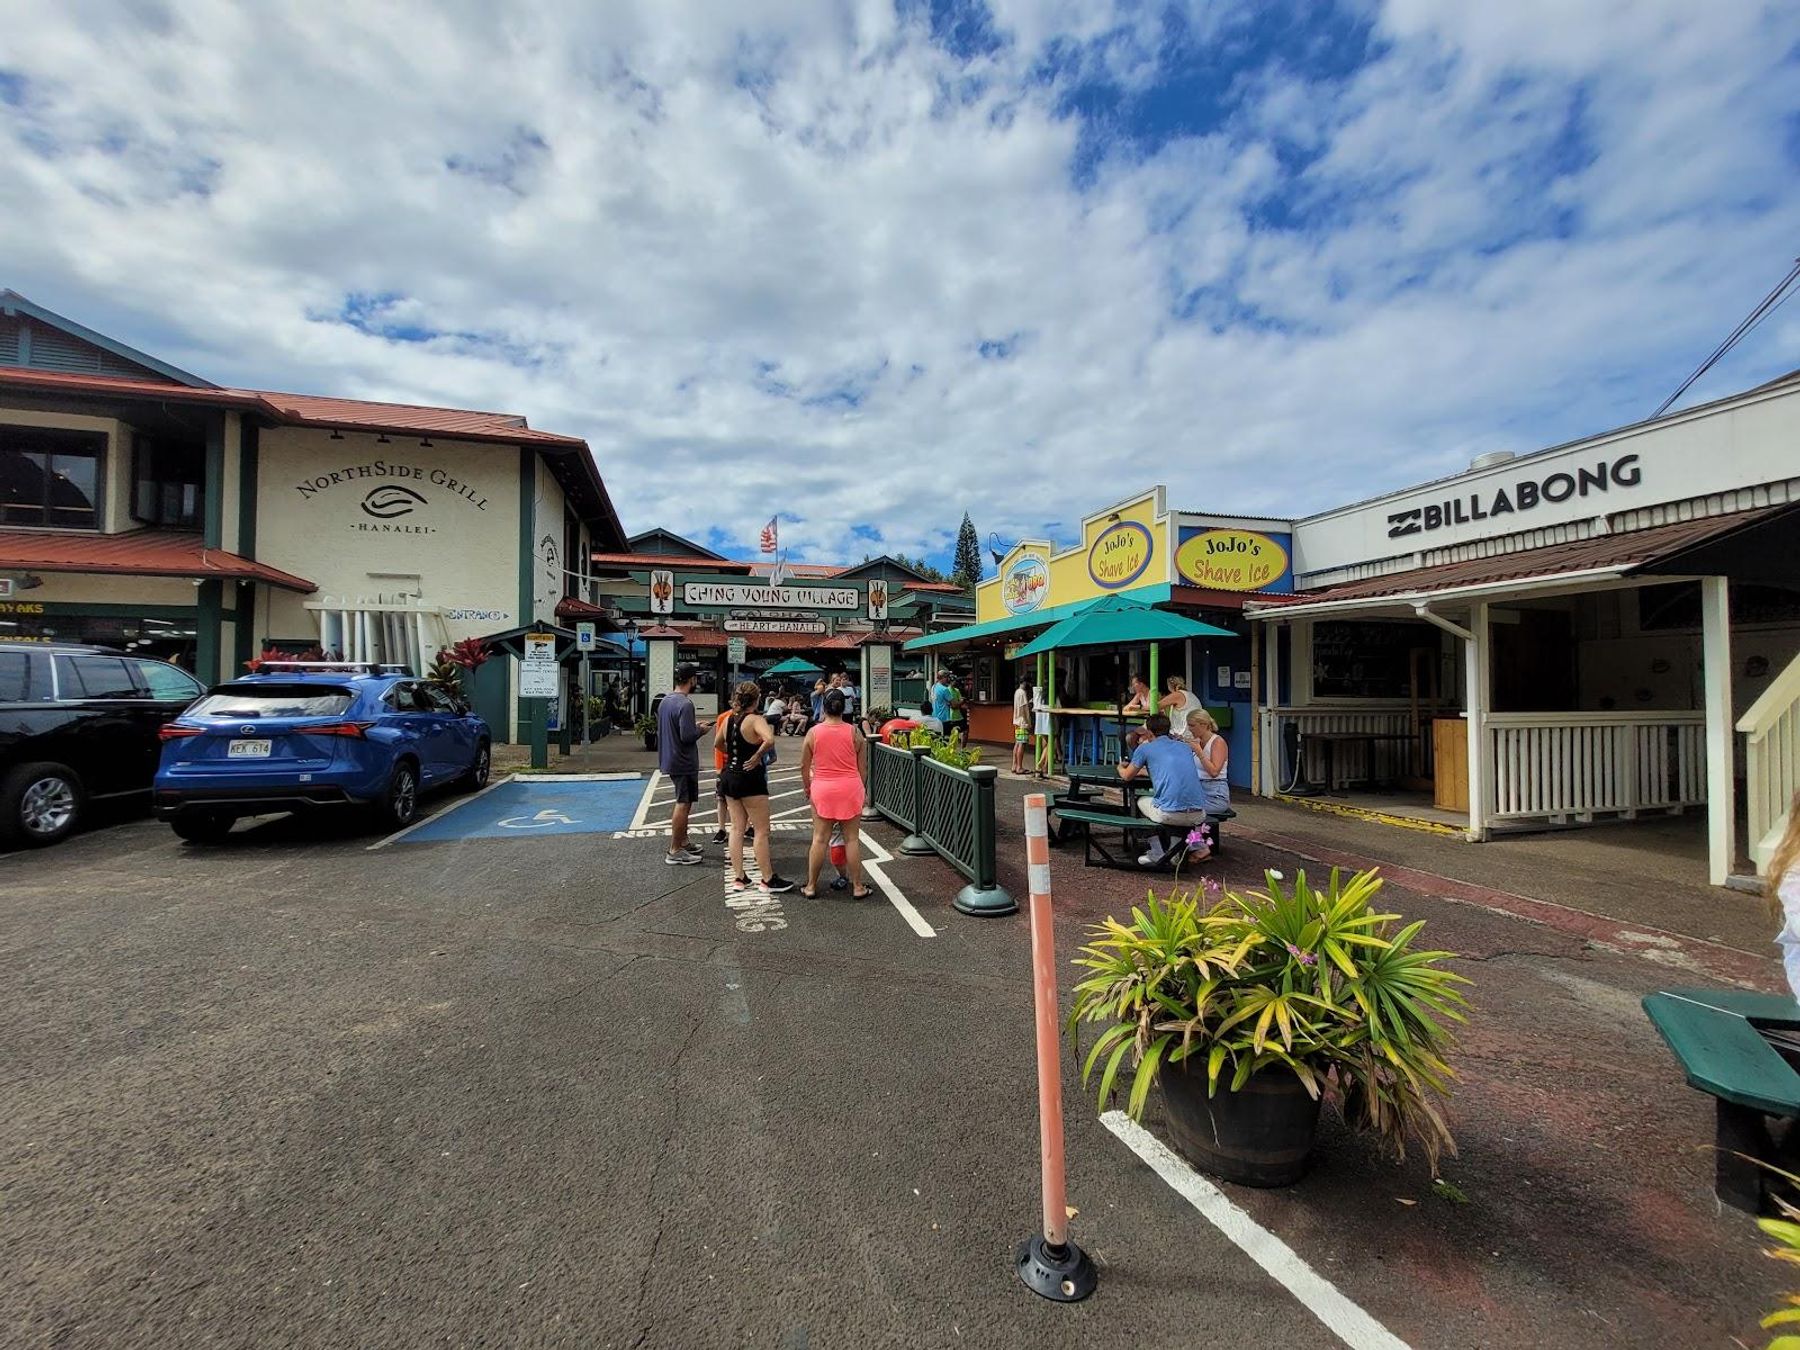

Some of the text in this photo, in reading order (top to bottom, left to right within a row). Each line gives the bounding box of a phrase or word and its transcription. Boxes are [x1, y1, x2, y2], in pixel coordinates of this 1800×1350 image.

[1423, 454, 1642, 531] BILLABONG
[1103, 532, 1135, 556] JoJo's
[1205, 536, 1262, 556] JoJo's
[1099, 552, 1140, 578] Shave Ice
[1194, 559, 1270, 584] Shave Ice
[688, 586, 855, 606] CHING YOUNG VILLAGE
[739, 621, 772, 631] HEART
[779, 623, 822, 632] HANALEI
